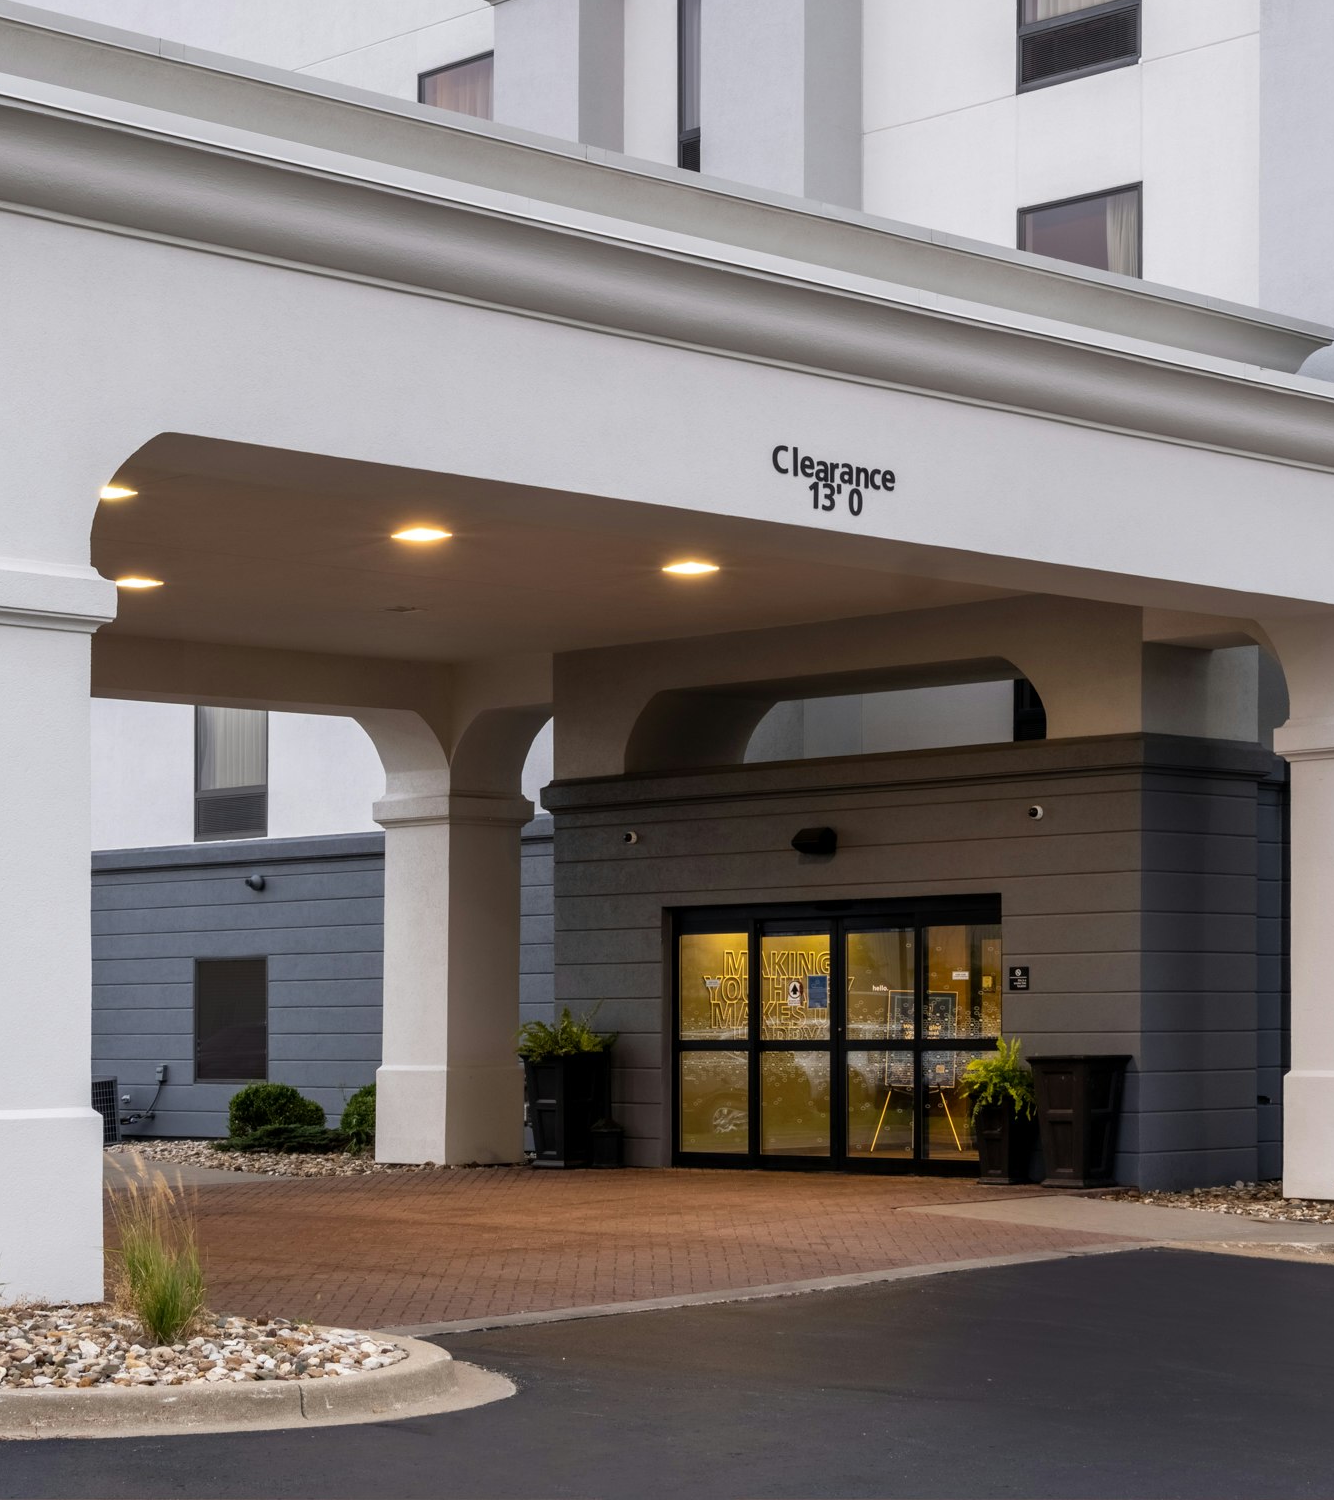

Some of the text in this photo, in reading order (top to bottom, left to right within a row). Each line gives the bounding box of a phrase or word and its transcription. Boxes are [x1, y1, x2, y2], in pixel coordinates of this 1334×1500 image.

[772, 445, 896, 491] Clearance
[809, 481, 863, 516] 13' 0
